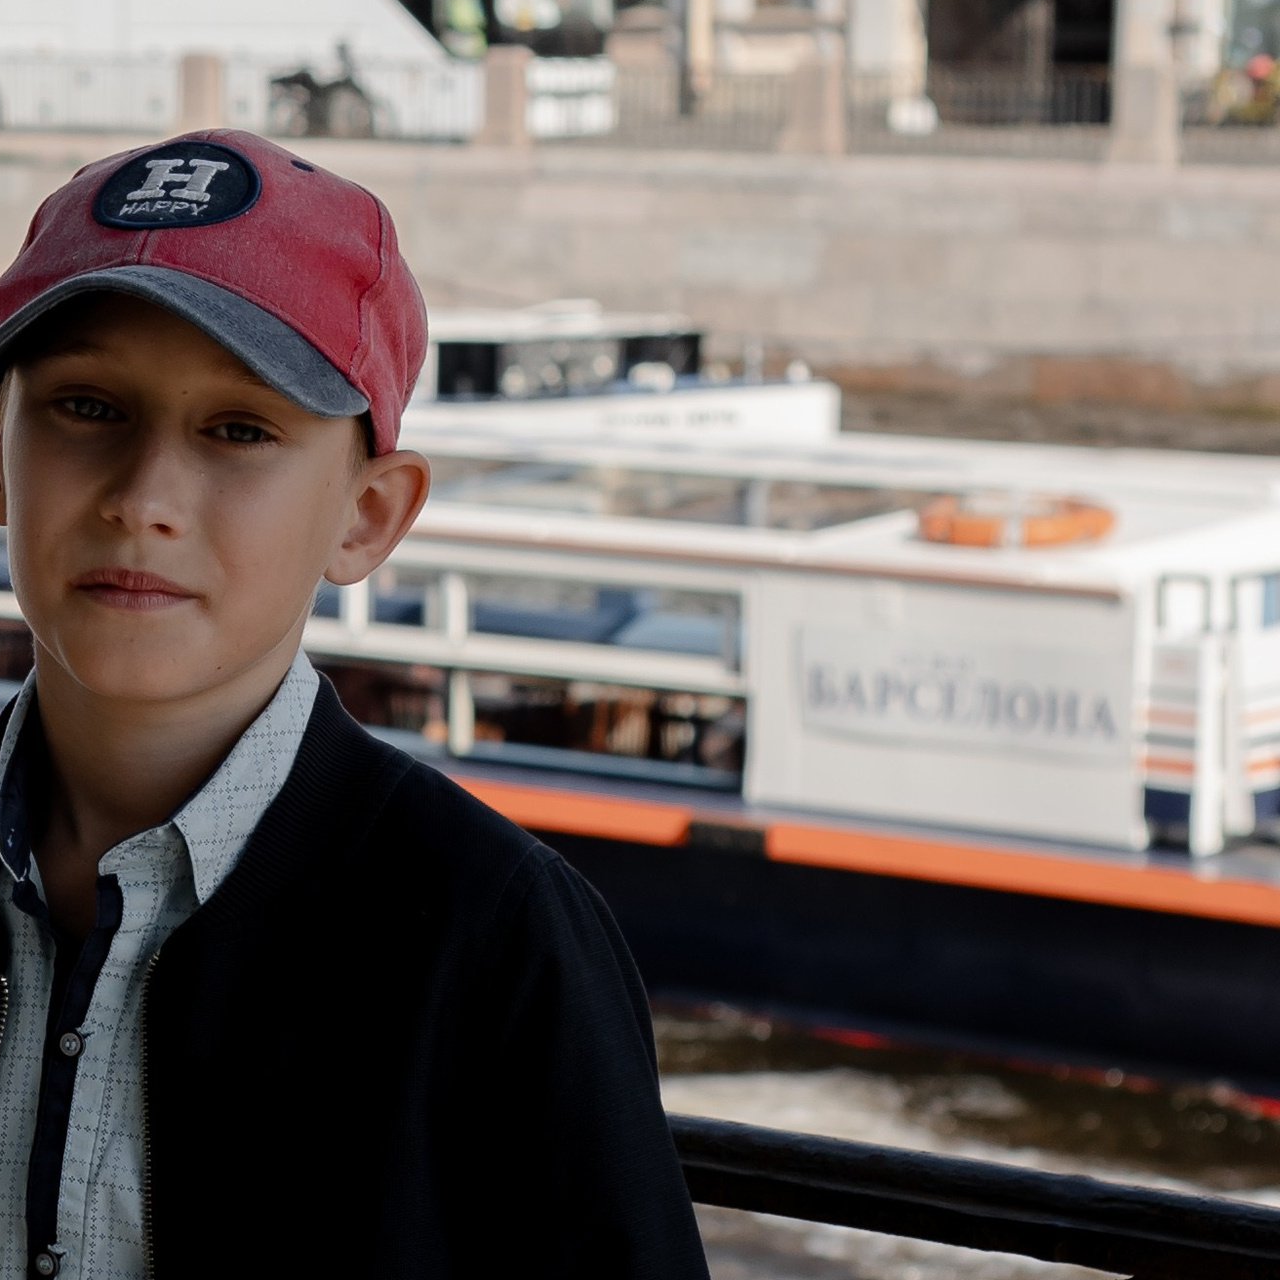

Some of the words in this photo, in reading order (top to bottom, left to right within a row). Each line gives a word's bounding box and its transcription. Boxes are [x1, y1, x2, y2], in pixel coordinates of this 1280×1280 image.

[126, 158, 230, 203] H
[119, 200, 209, 217] HAPPY
[808, 660, 1118, 742] БАРСЕЛОНА
